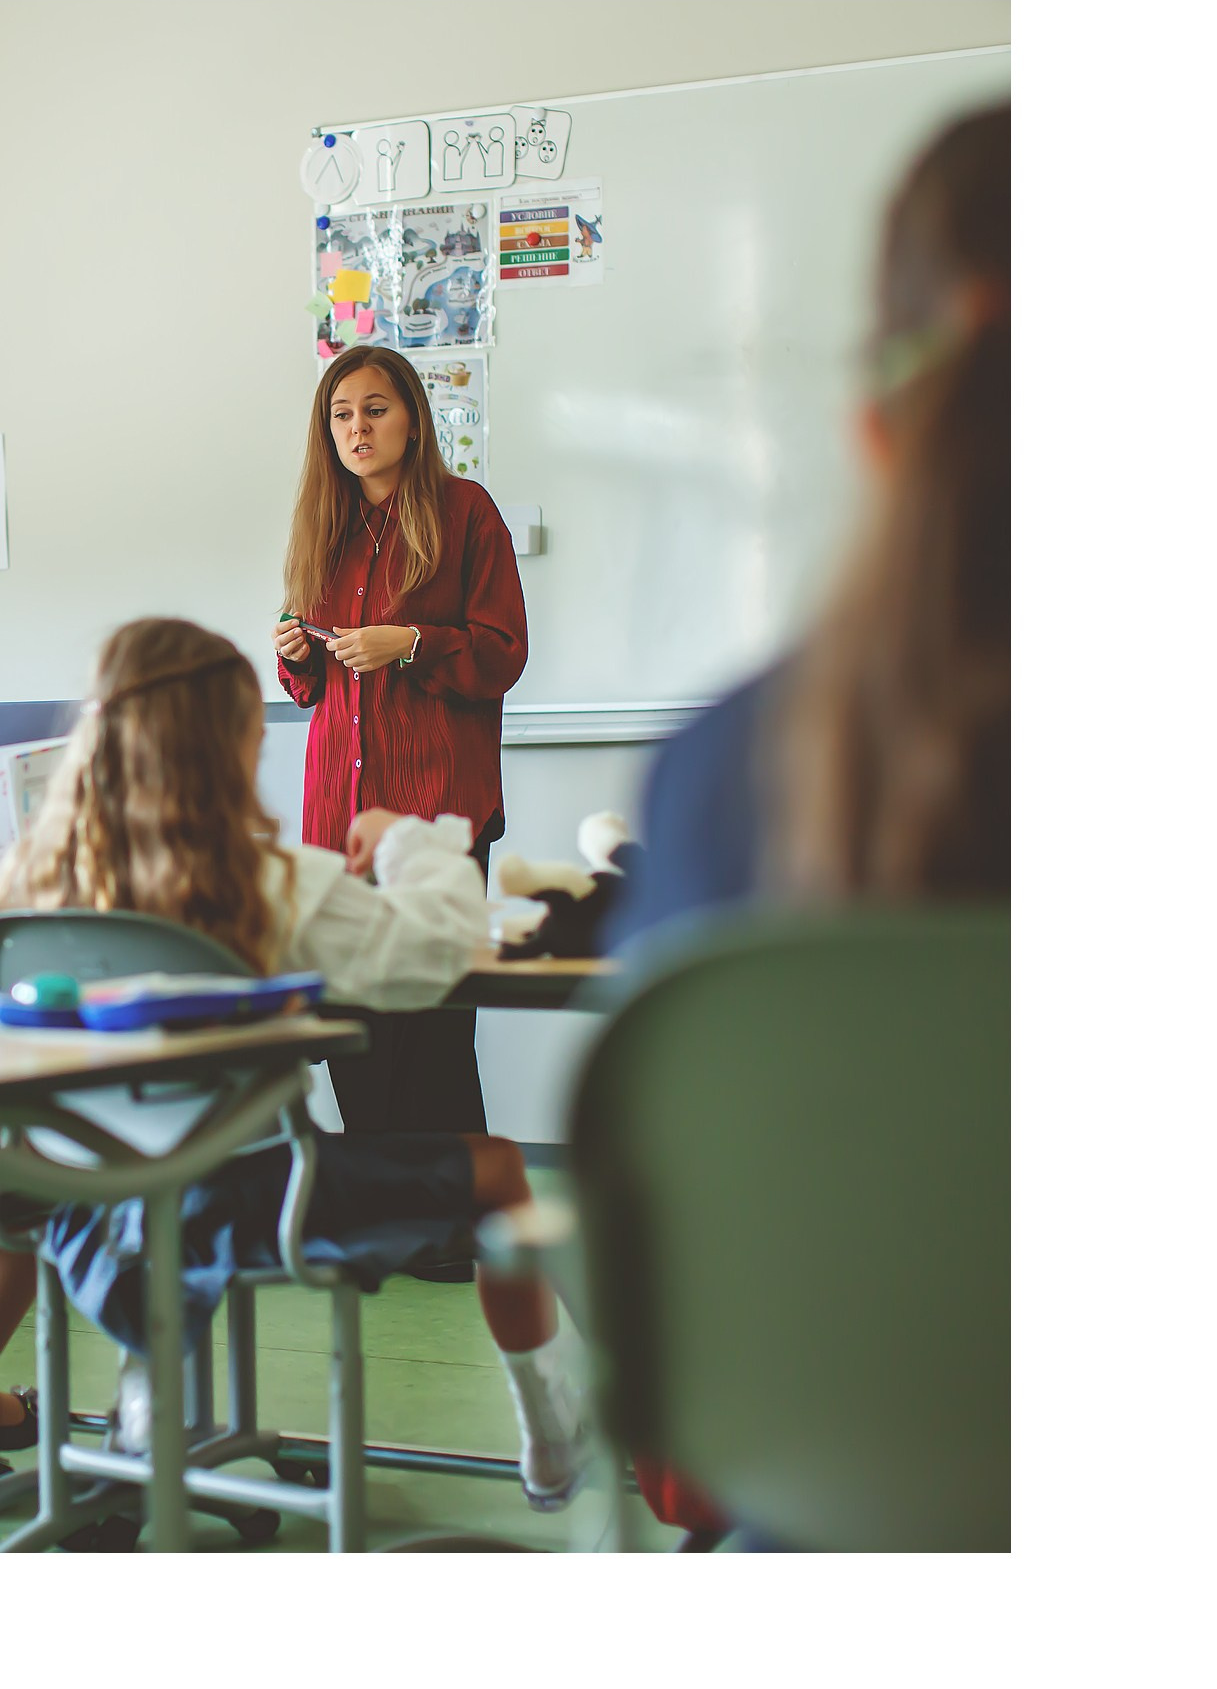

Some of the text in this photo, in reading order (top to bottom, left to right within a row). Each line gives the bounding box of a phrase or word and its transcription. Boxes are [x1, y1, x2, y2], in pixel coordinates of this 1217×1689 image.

[511, 209, 558, 222] УСЛОВИЕ
[516, 238, 552, 249] СХМА
[511, 251, 558, 263] РЕШЕНИЕ
[518, 267, 550, 278] ОТВЕТ
